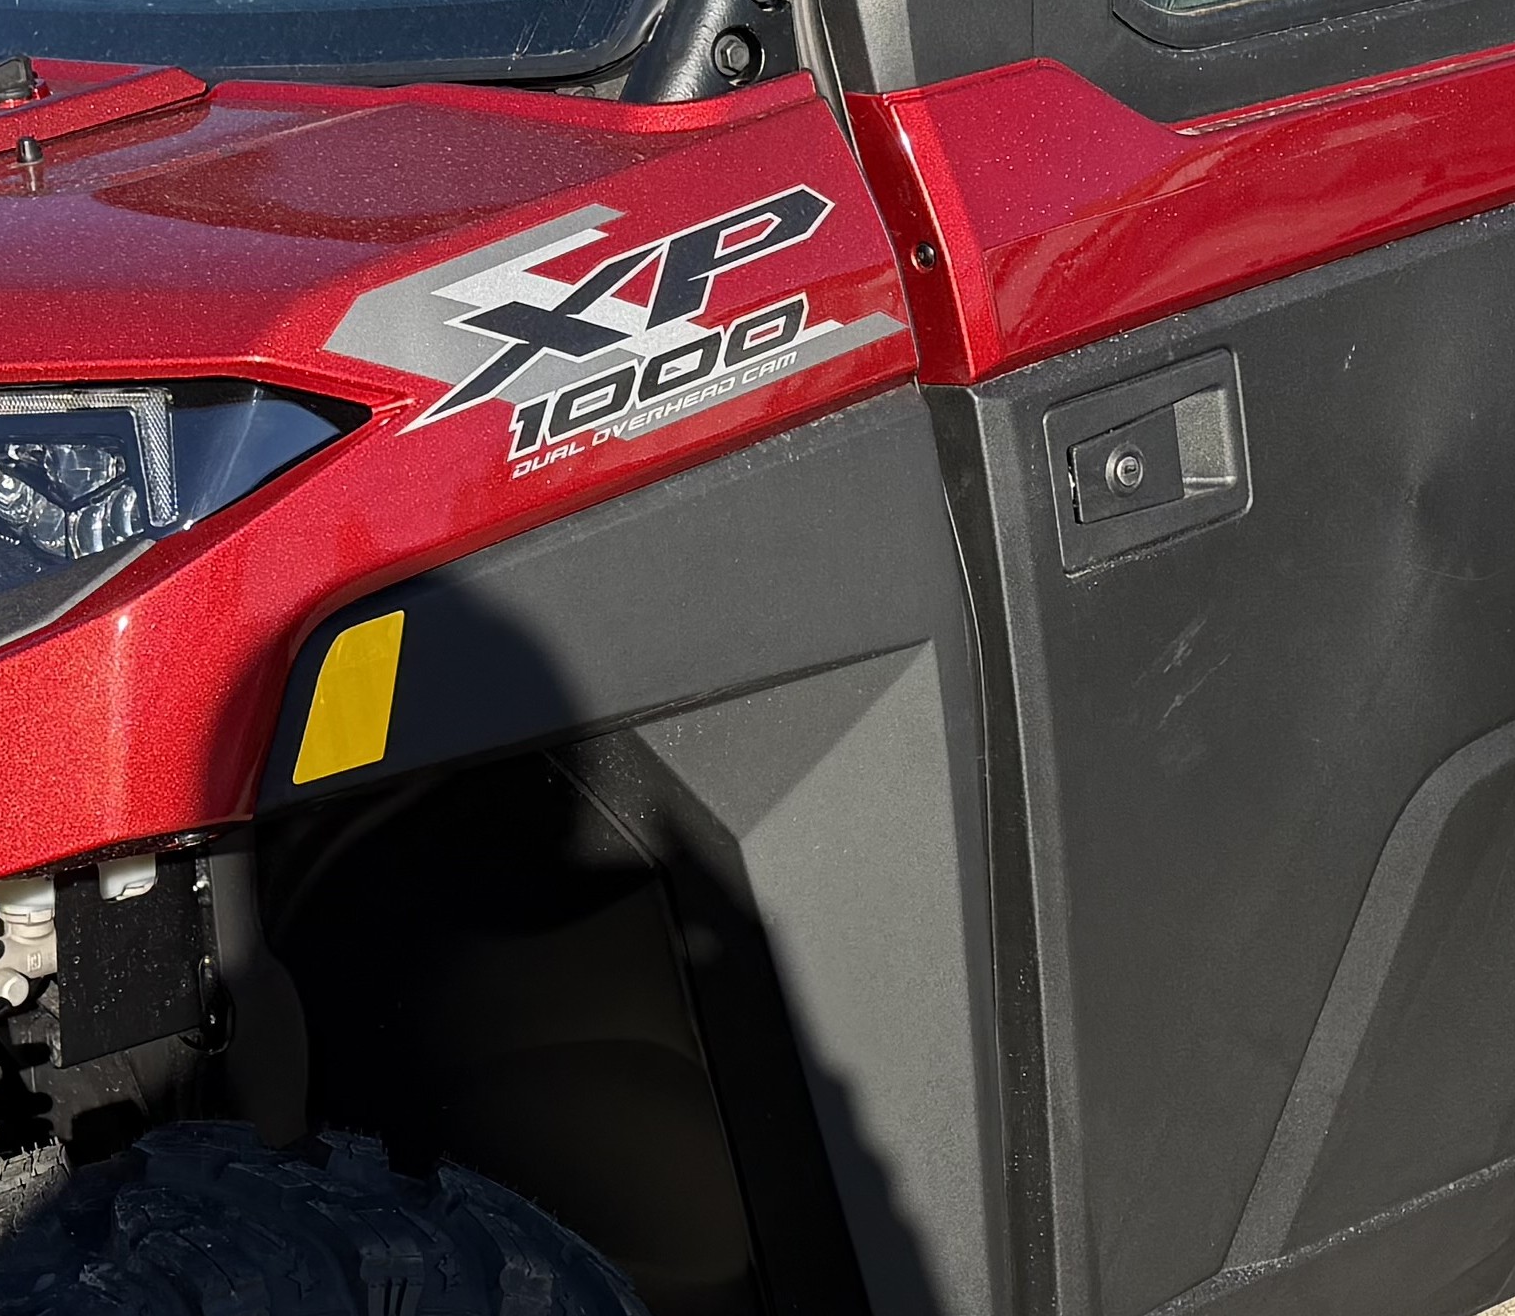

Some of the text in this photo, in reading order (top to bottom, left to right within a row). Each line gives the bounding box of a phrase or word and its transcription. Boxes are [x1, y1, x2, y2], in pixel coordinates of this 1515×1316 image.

[396, 182, 836, 436] XP
[507, 295, 809, 462] 1000
[511, 351, 799, 479] DUAL OVERHEAD CAM
